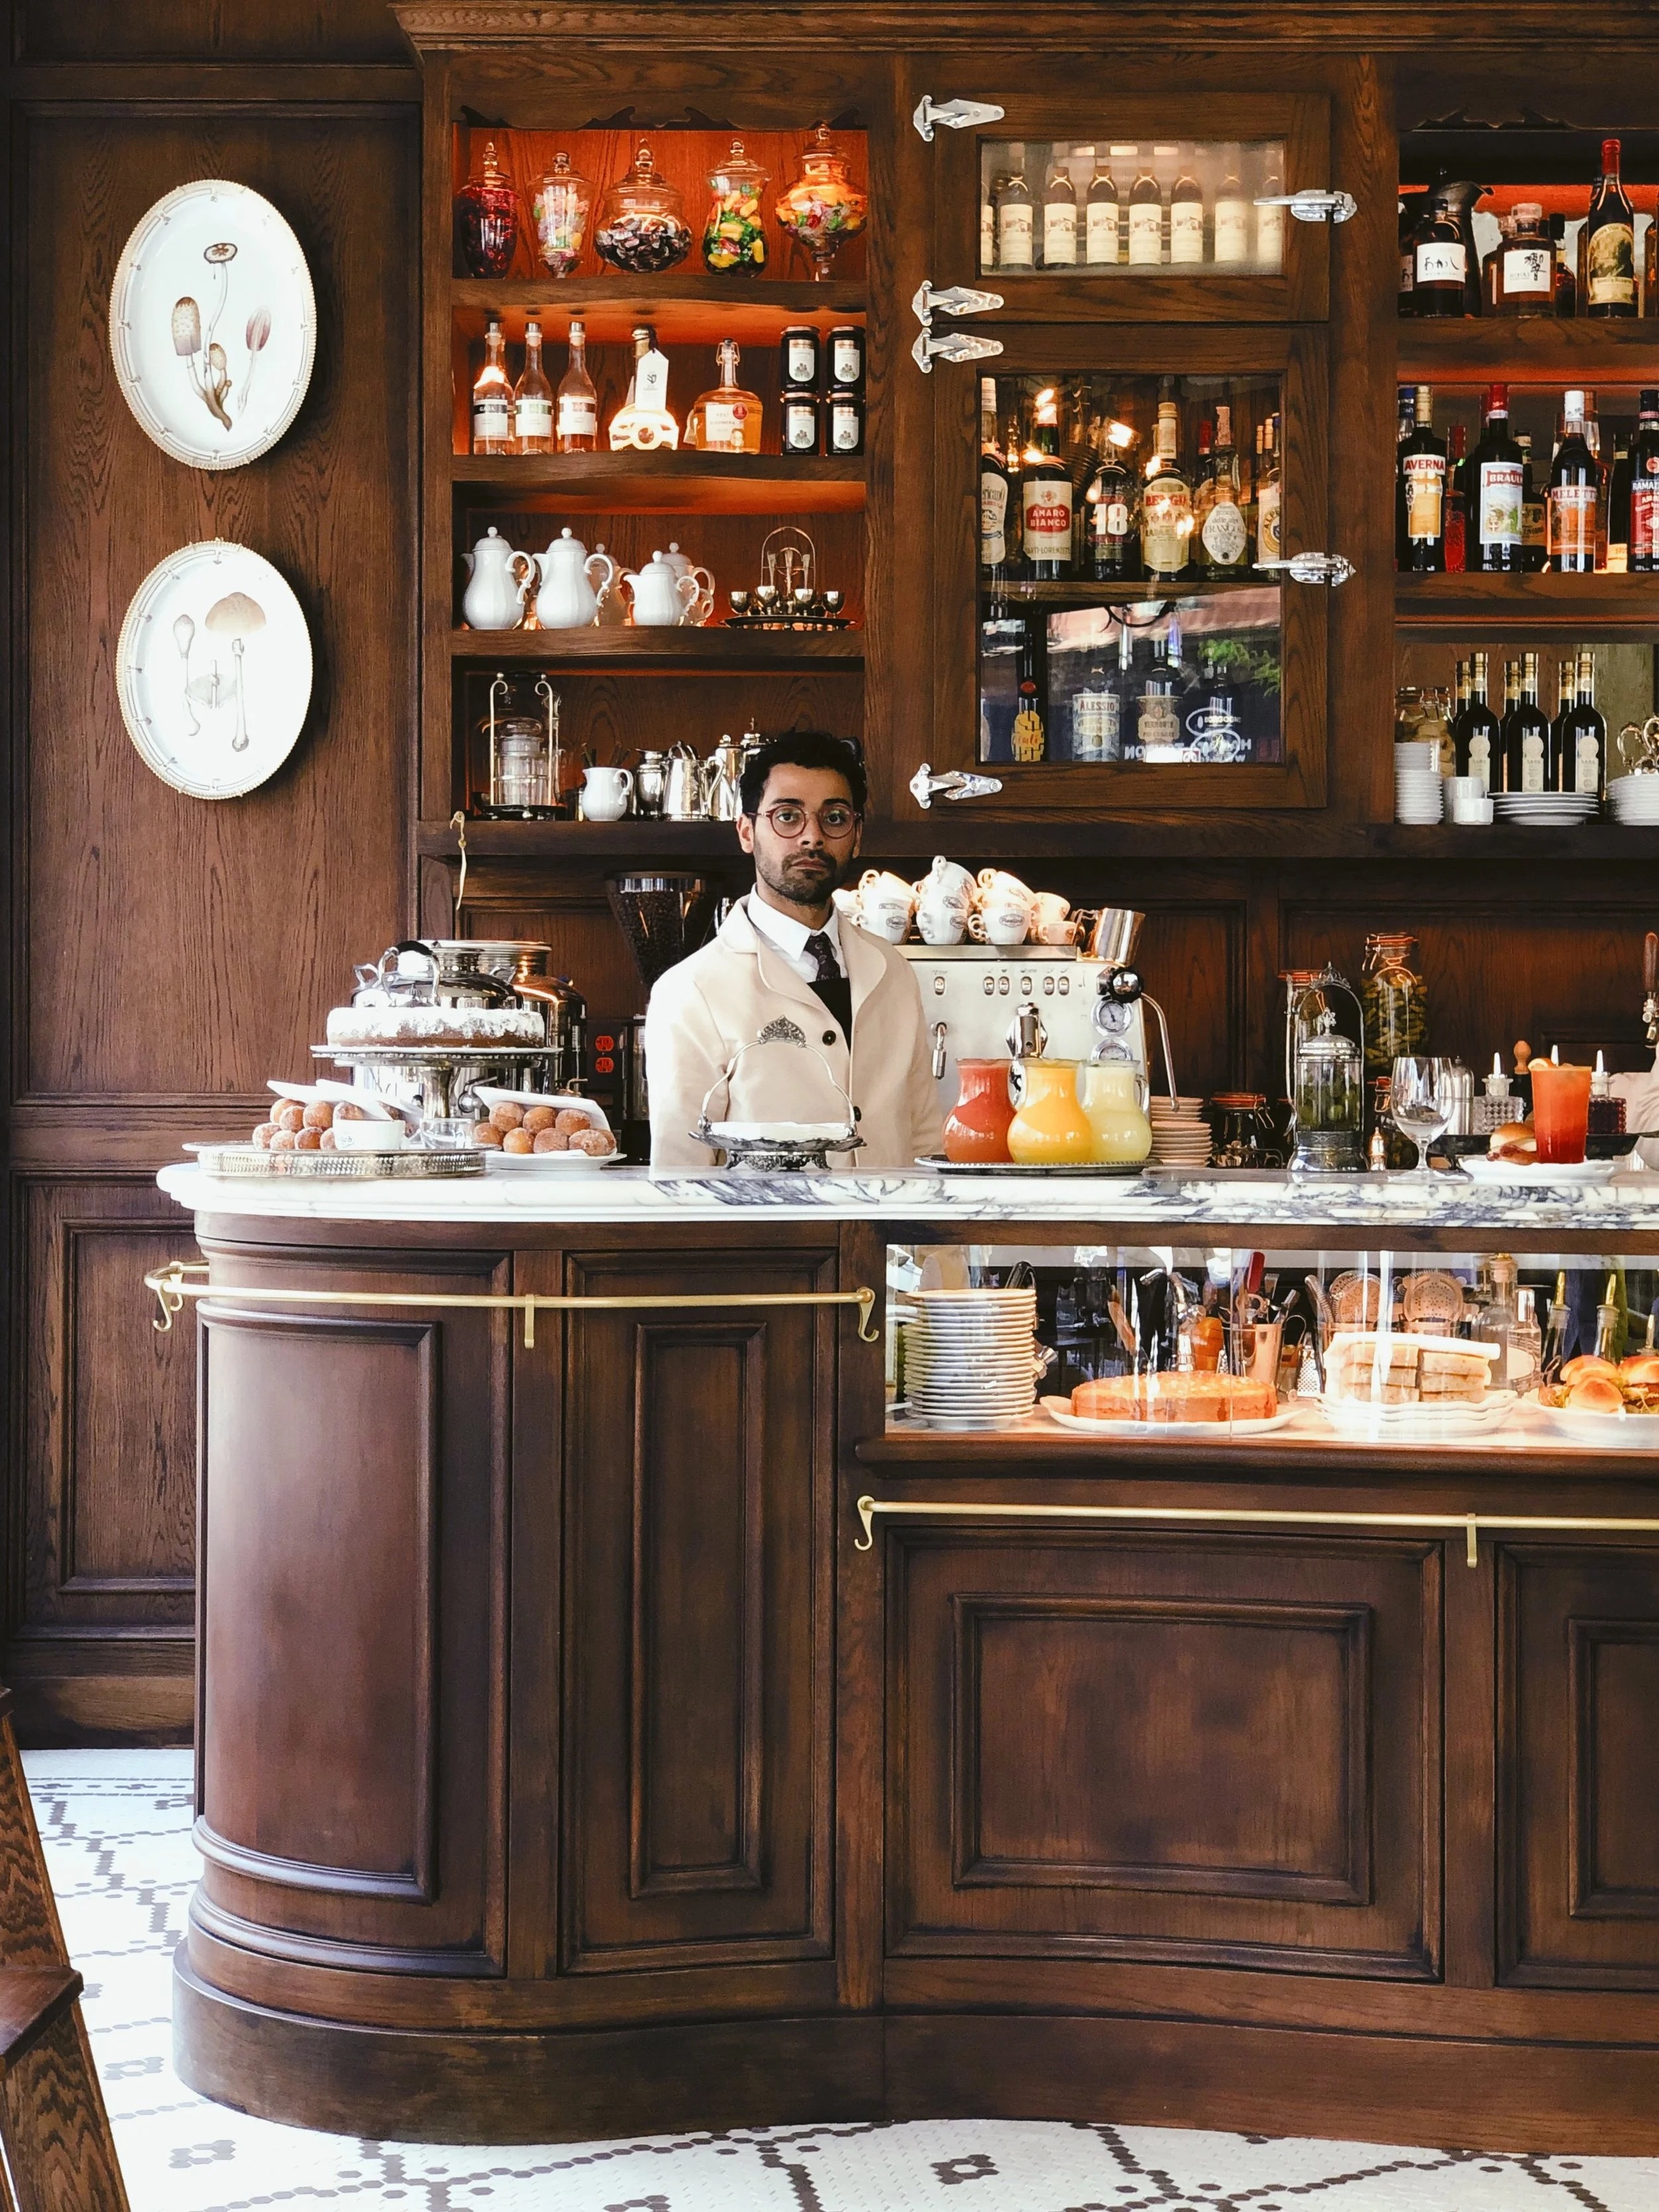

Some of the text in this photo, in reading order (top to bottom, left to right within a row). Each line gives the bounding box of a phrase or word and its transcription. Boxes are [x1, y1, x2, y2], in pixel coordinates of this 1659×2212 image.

[1404, 459, 1445, 471] AVERNA
[1094, 504, 1128, 535] 18
[1080, 699, 1115, 711] ALESSIO
